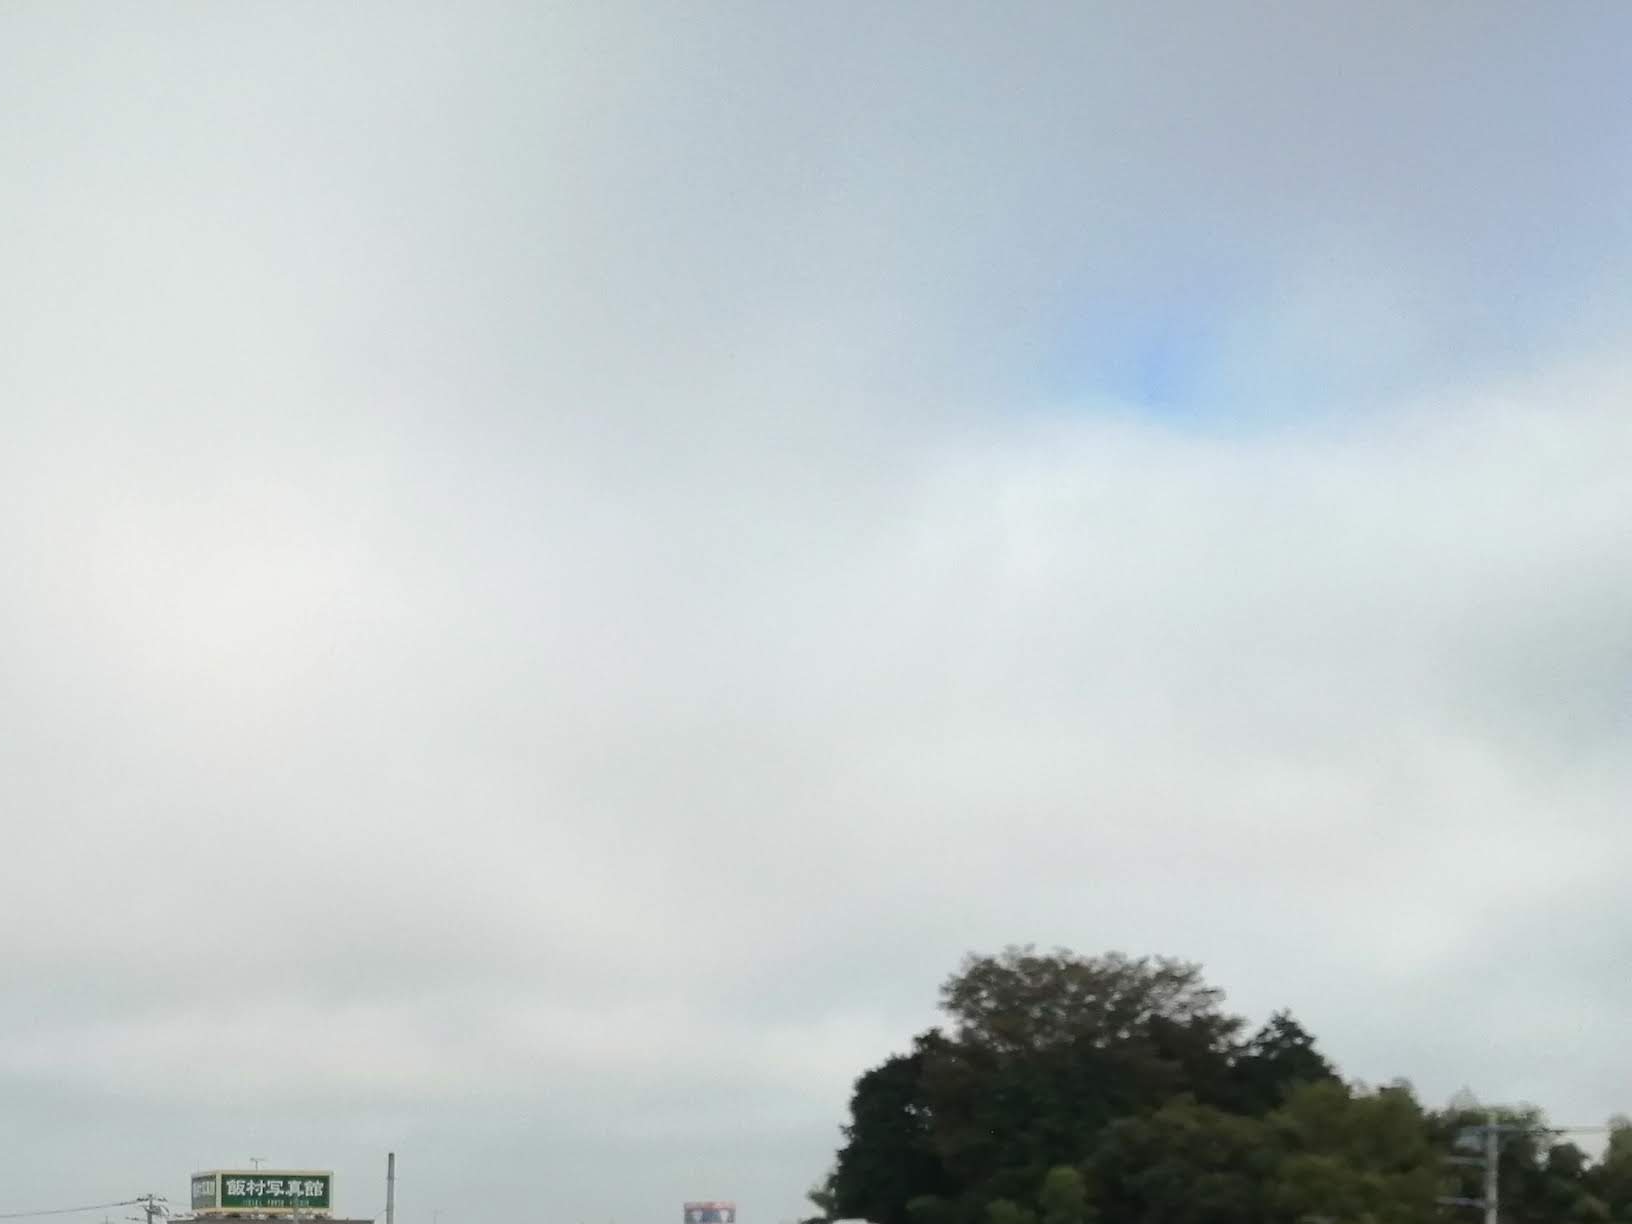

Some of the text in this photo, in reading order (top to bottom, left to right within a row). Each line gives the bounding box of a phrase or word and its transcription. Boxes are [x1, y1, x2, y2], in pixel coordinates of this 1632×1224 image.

[226, 1179, 324, 1197] 飯村写真館
